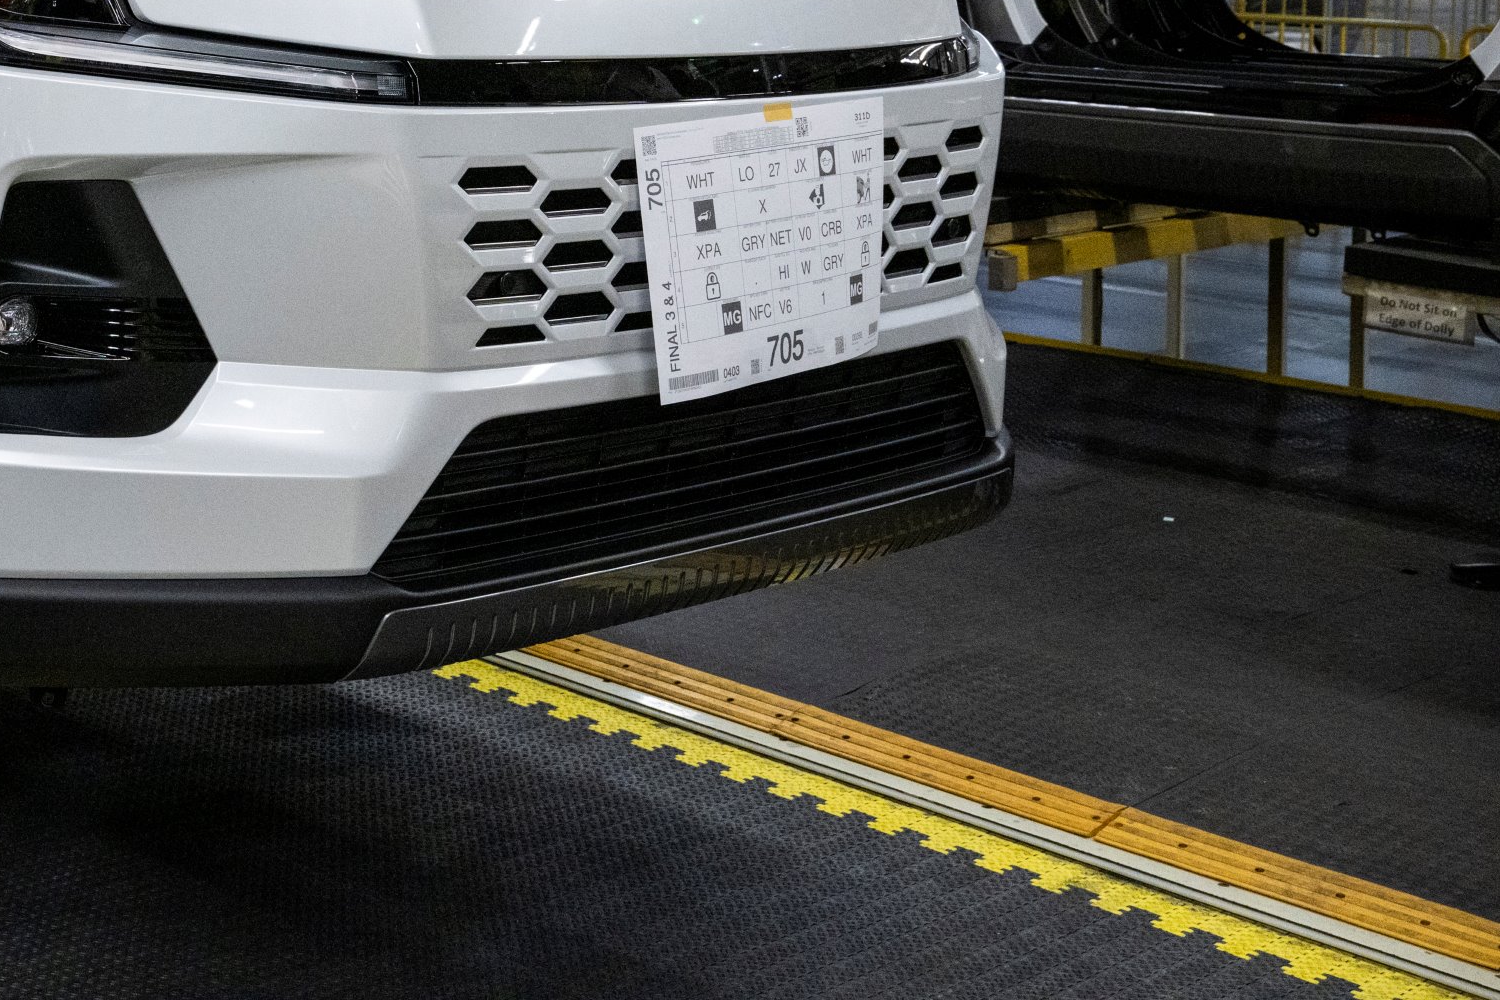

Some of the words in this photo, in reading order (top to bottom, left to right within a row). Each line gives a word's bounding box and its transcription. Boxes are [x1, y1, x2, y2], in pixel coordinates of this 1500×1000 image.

[686, 171, 715, 190] WHT
[768, 162, 781, 178] 27
[794, 158, 807, 174] JX
[851, 147, 872, 164] WHT
[645, 168, 663, 211] 705
[758, 199, 767, 214] X
[696, 242, 722, 260] XPA
[741, 233, 765, 253] GRY
[770, 228, 792, 247] NET
[821, 220, 843, 238] CRB
[856, 213, 873, 230] XPA
[778, 264, 790, 280] HI
[801, 260, 811, 275] W
[823, 253, 844, 271] GRY
[662, 281, 672, 291] 4
[663, 296, 674, 306] &
[722, 309, 742, 327] MG
[749, 303, 772, 322] NFC
[778, 299, 793, 315] V6
[850, 281, 863, 298] MG
[1380, 296, 1396, 308] Do
[1399, 299, 1421, 312] Not
[1424, 303, 1440, 316] Sit
[1442, 308, 1457, 319] on
[665, 311, 676, 321] 3
[1379, 313, 1406, 329] Edge
[1409, 319, 1422, 330] of
[1424, 321, 1456, 338] Dolly
[667, 324, 681, 373] FINAL
[766, 329, 805, 367] 705
[723, 365, 740, 379] 0403
